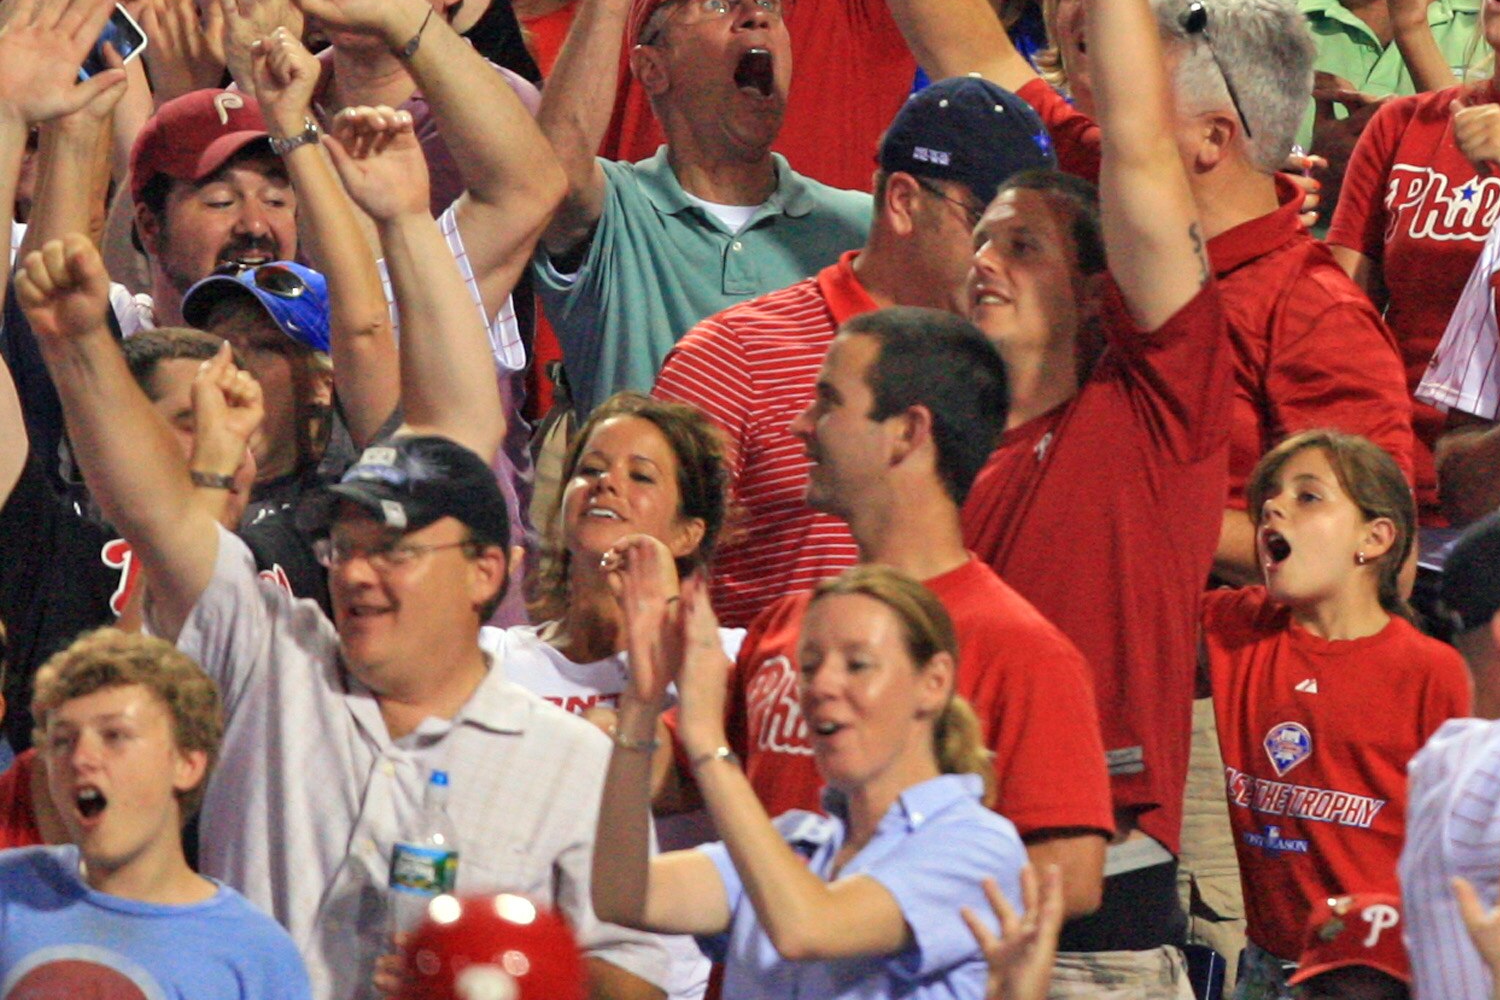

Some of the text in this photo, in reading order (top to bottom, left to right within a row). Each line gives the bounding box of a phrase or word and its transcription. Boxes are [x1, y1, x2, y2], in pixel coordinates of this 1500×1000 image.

[213, 92, 244, 125] P
[1254, 778, 1293, 816] THE
[1287, 784, 1386, 829] TROPHY
[1361, 904, 1400, 948] P
